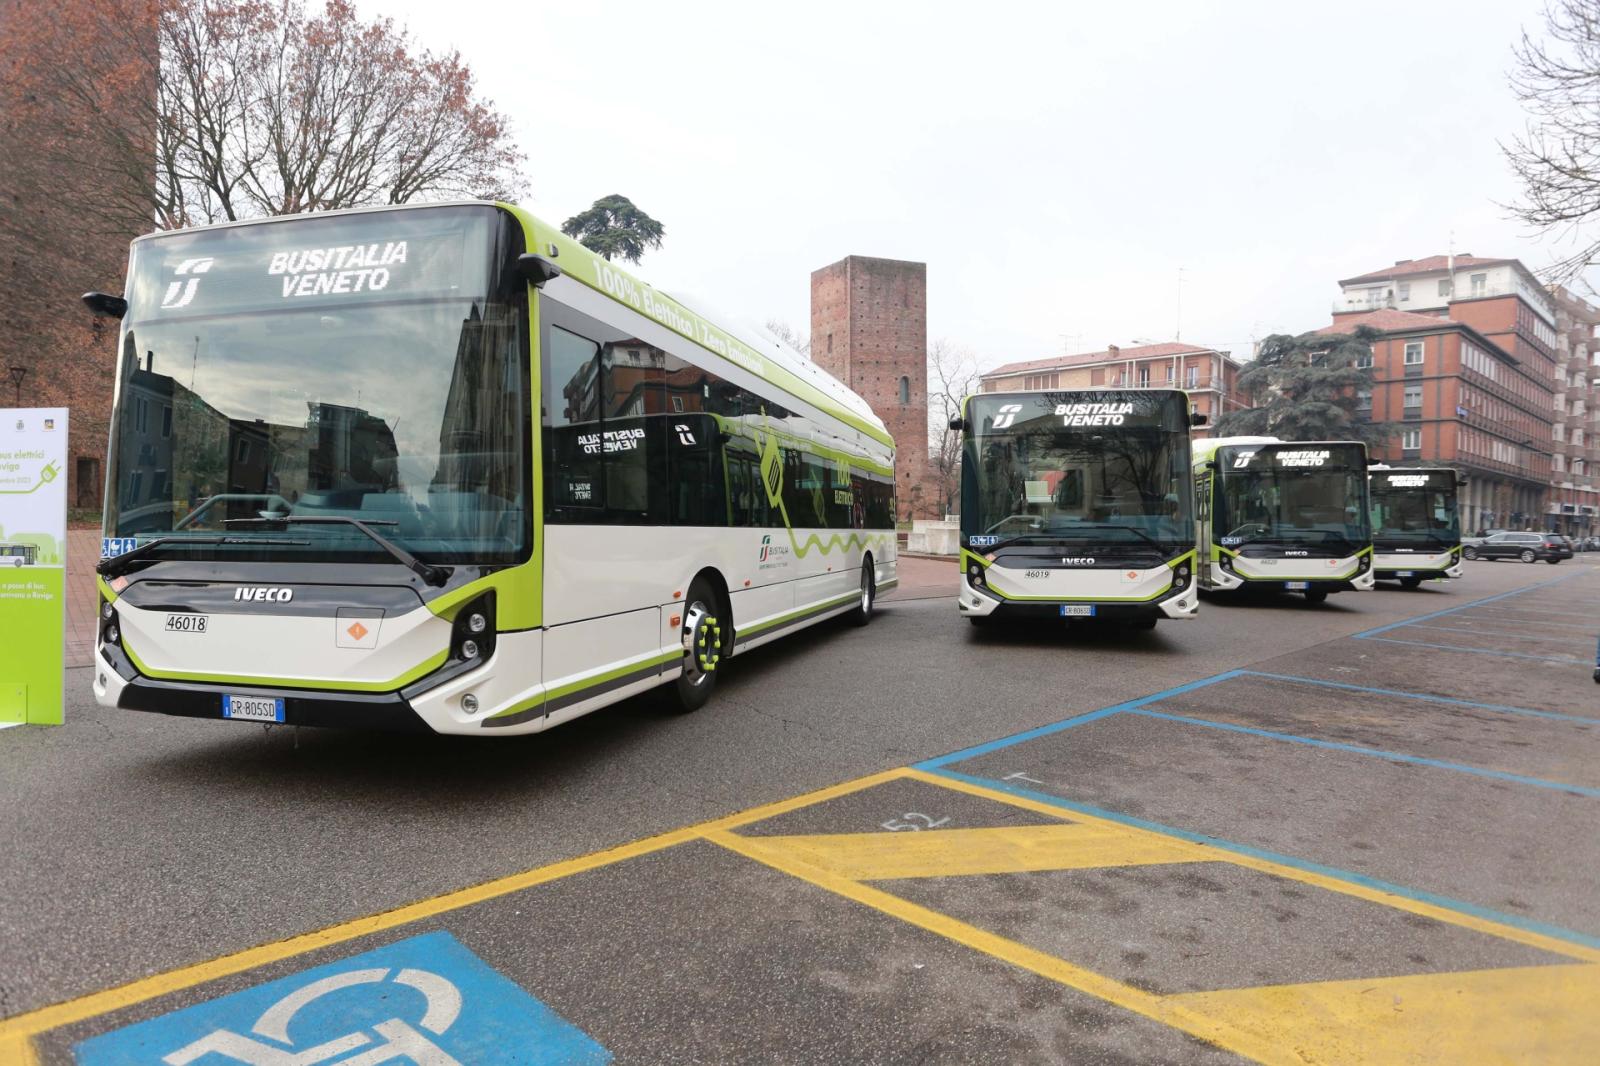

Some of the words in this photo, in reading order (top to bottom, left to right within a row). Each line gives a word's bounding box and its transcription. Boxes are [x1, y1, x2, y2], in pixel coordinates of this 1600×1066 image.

[268, 241, 408, 275] BUSITALIA
[282, 267, 390, 298] VENETO
[593, 259, 641, 308] 100%
[642, 288, 693, 337] Elettrico
[703, 326, 727, 352] Zero
[1054, 402, 1134, 416] BUSITALIA
[1063, 414, 1125, 427] VENETO
[1275, 450, 1330, 460] BUSITALIA
[0, 461, 20, 472] vigo
[1281, 458, 1324, 467] VENETO
[1062, 557, 1095, 565] IVECO
[1025, 570, 1050, 578] 46019
[234, 587, 293, 602] IVECO
[167, 615, 206, 631] 46018
